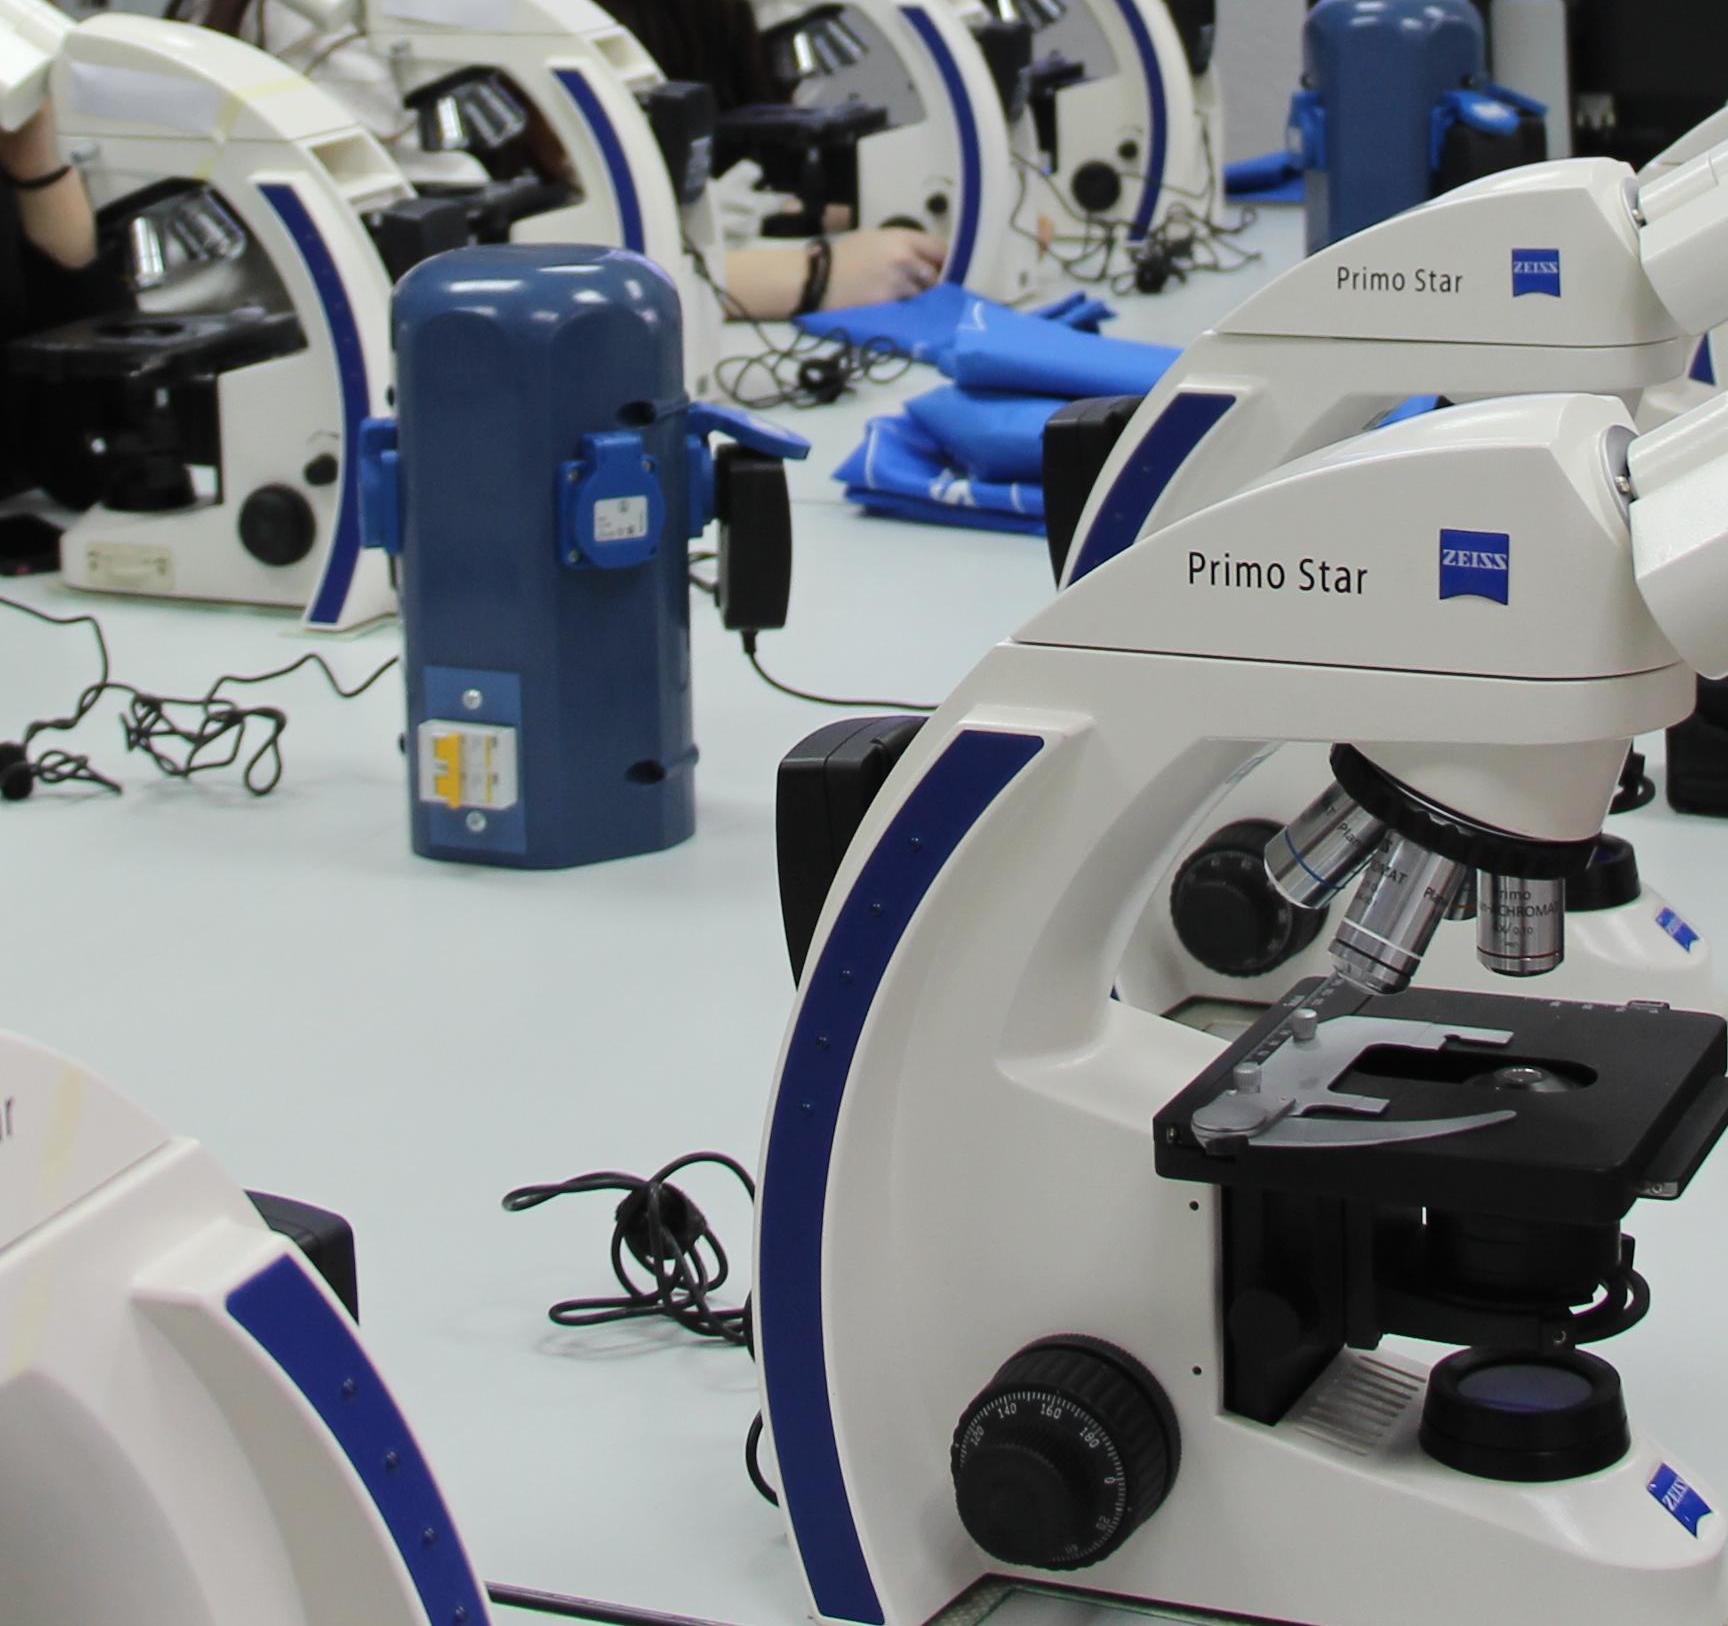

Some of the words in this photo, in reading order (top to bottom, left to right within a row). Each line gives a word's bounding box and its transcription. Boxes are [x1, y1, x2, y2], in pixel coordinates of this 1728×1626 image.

[1513, 261, 1559, 274] ZEISS
[1337, 266, 1406, 292] Primo
[1415, 268, 1464, 294] Star
[1442, 548, 1508, 571] ZEISS
[1188, 551, 1286, 590] Primo
[1298, 558, 1369, 595] Star
[998, 1402, 1017, 1420] 140
[1040, 1403, 1063, 1420] 160
[1079, 1426, 1100, 1448] 180
